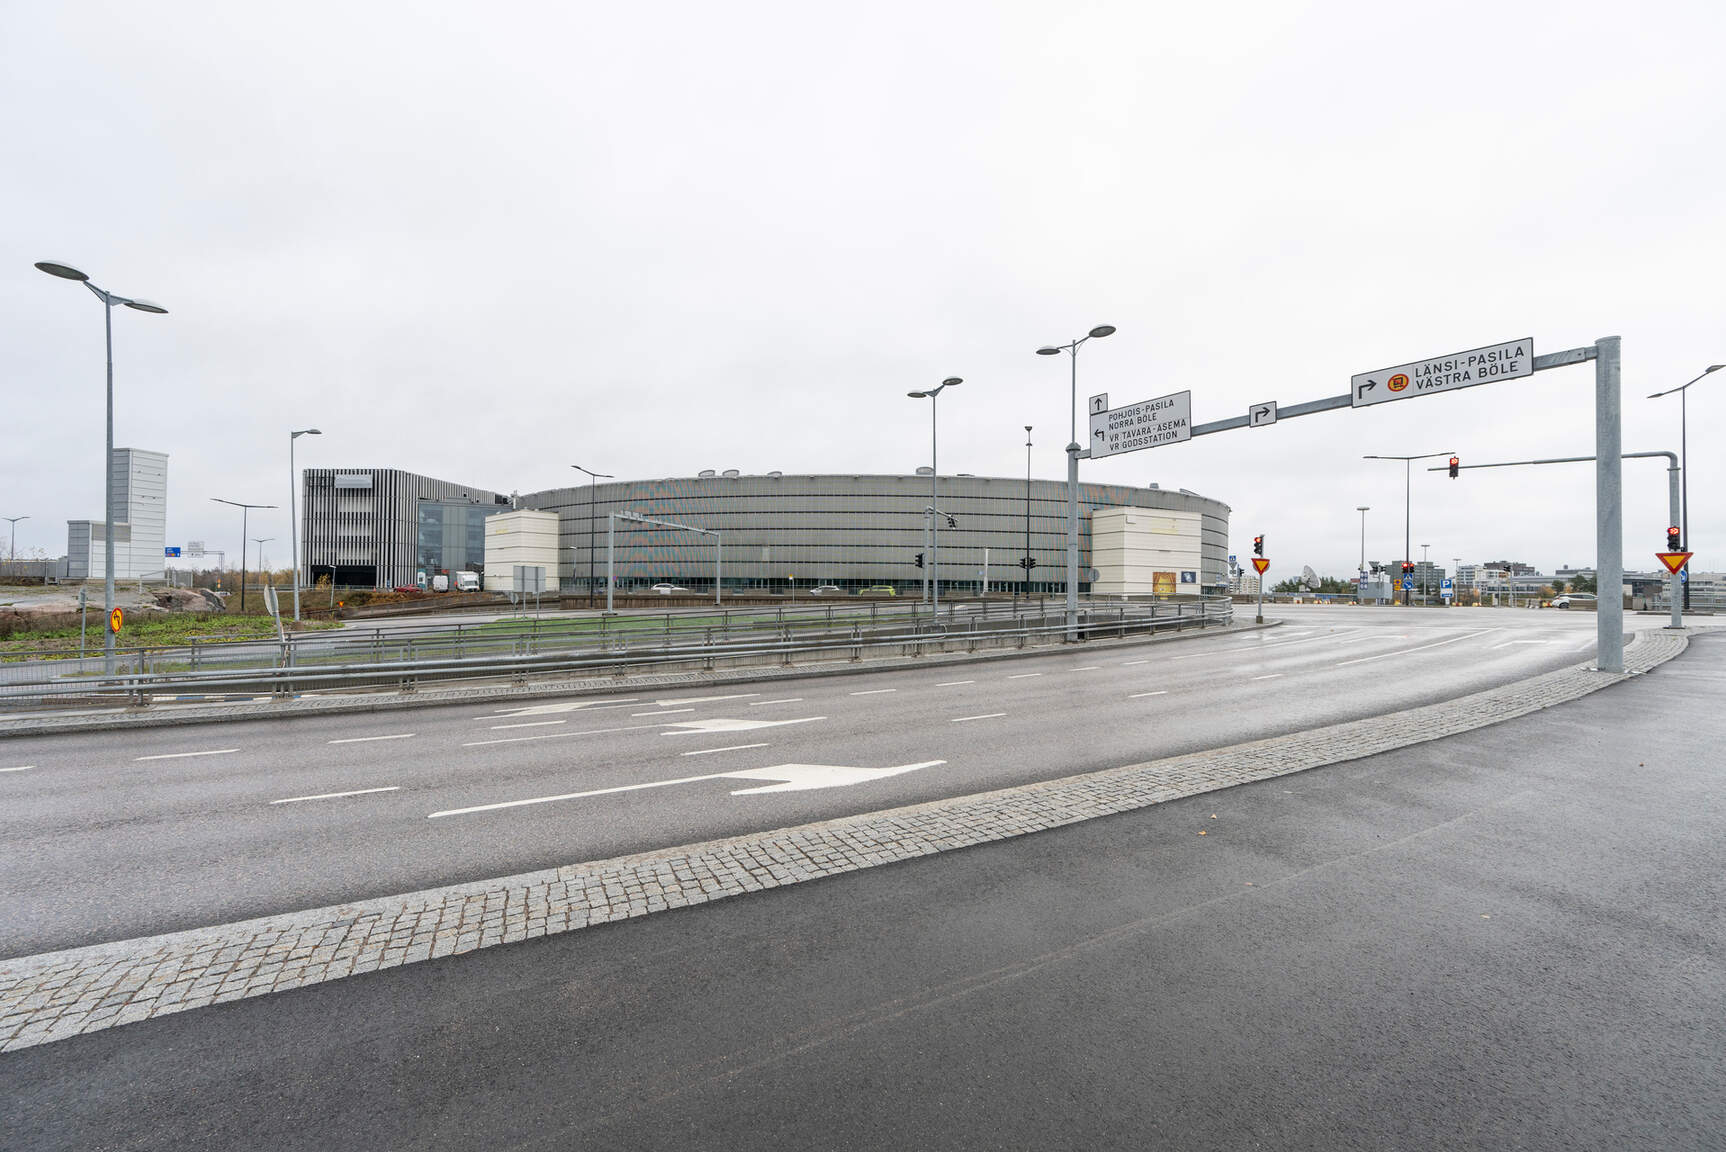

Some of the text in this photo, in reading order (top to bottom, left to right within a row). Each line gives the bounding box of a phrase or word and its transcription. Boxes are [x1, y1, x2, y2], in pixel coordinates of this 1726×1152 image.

[1415, 346, 1524, 378] LÄNSI-PASILA
[1416, 361, 1518, 390] VÄSTRA BÖLE
[1108, 399, 1174, 421] POHJOIS-PASILA
[1108, 418, 1134, 431] NORRA
[1109, 433, 1120, 442] VR
[1109, 430, 1178, 451] VR GODSSTATION
